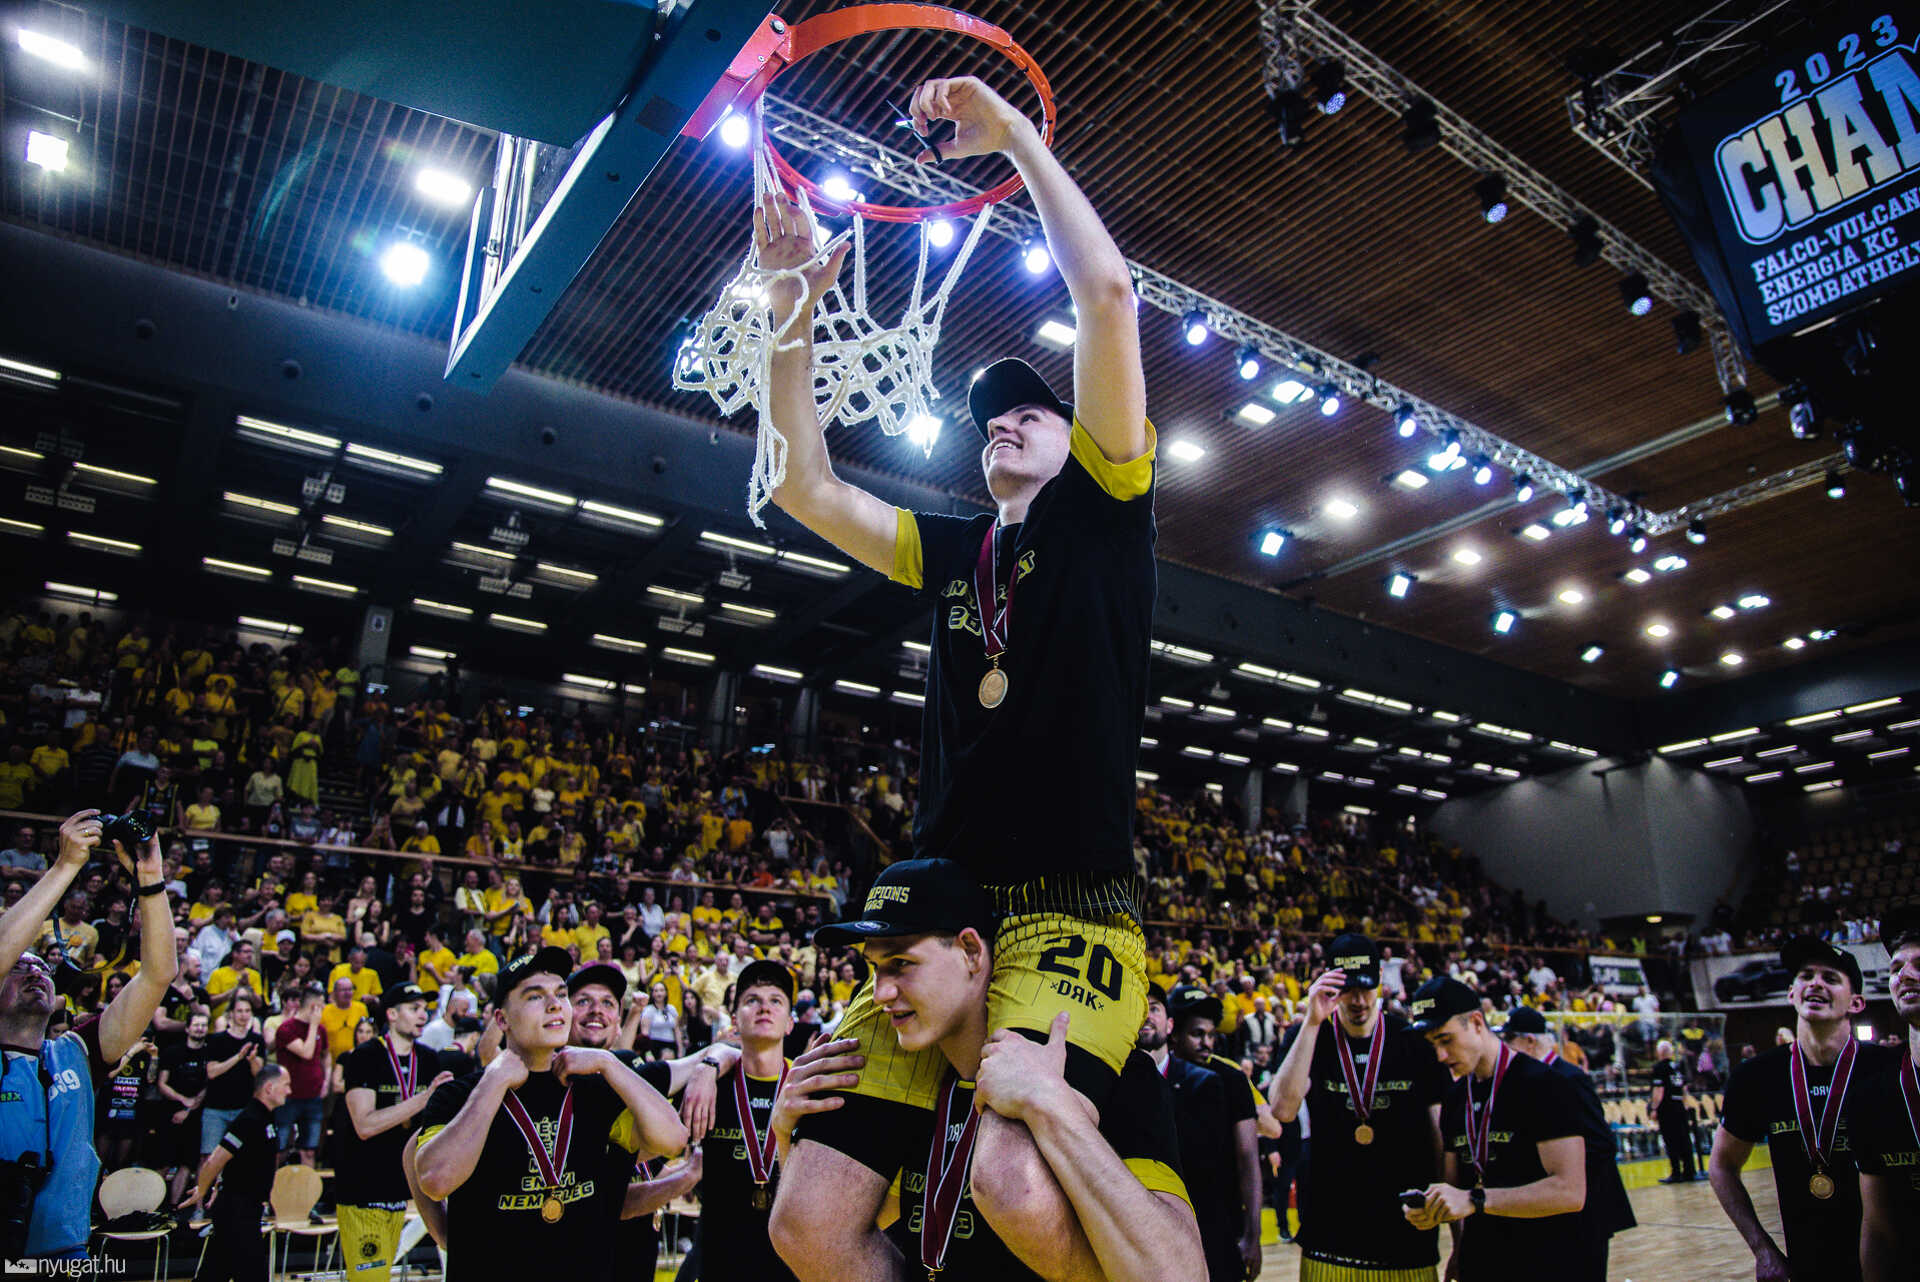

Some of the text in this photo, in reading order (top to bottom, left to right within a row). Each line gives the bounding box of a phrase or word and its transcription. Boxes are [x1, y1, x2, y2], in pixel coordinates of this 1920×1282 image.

[1775, 14, 1899, 103] 2023
[1751, 187, 1920, 283] FALCO-VULCAN
[1758, 226, 1899, 305] ENERGIA KC
[1037, 934, 1123, 1002] 20
[499, 1194, 545, 1210] NEM
[521, 1171, 576, 1192] ENYI
